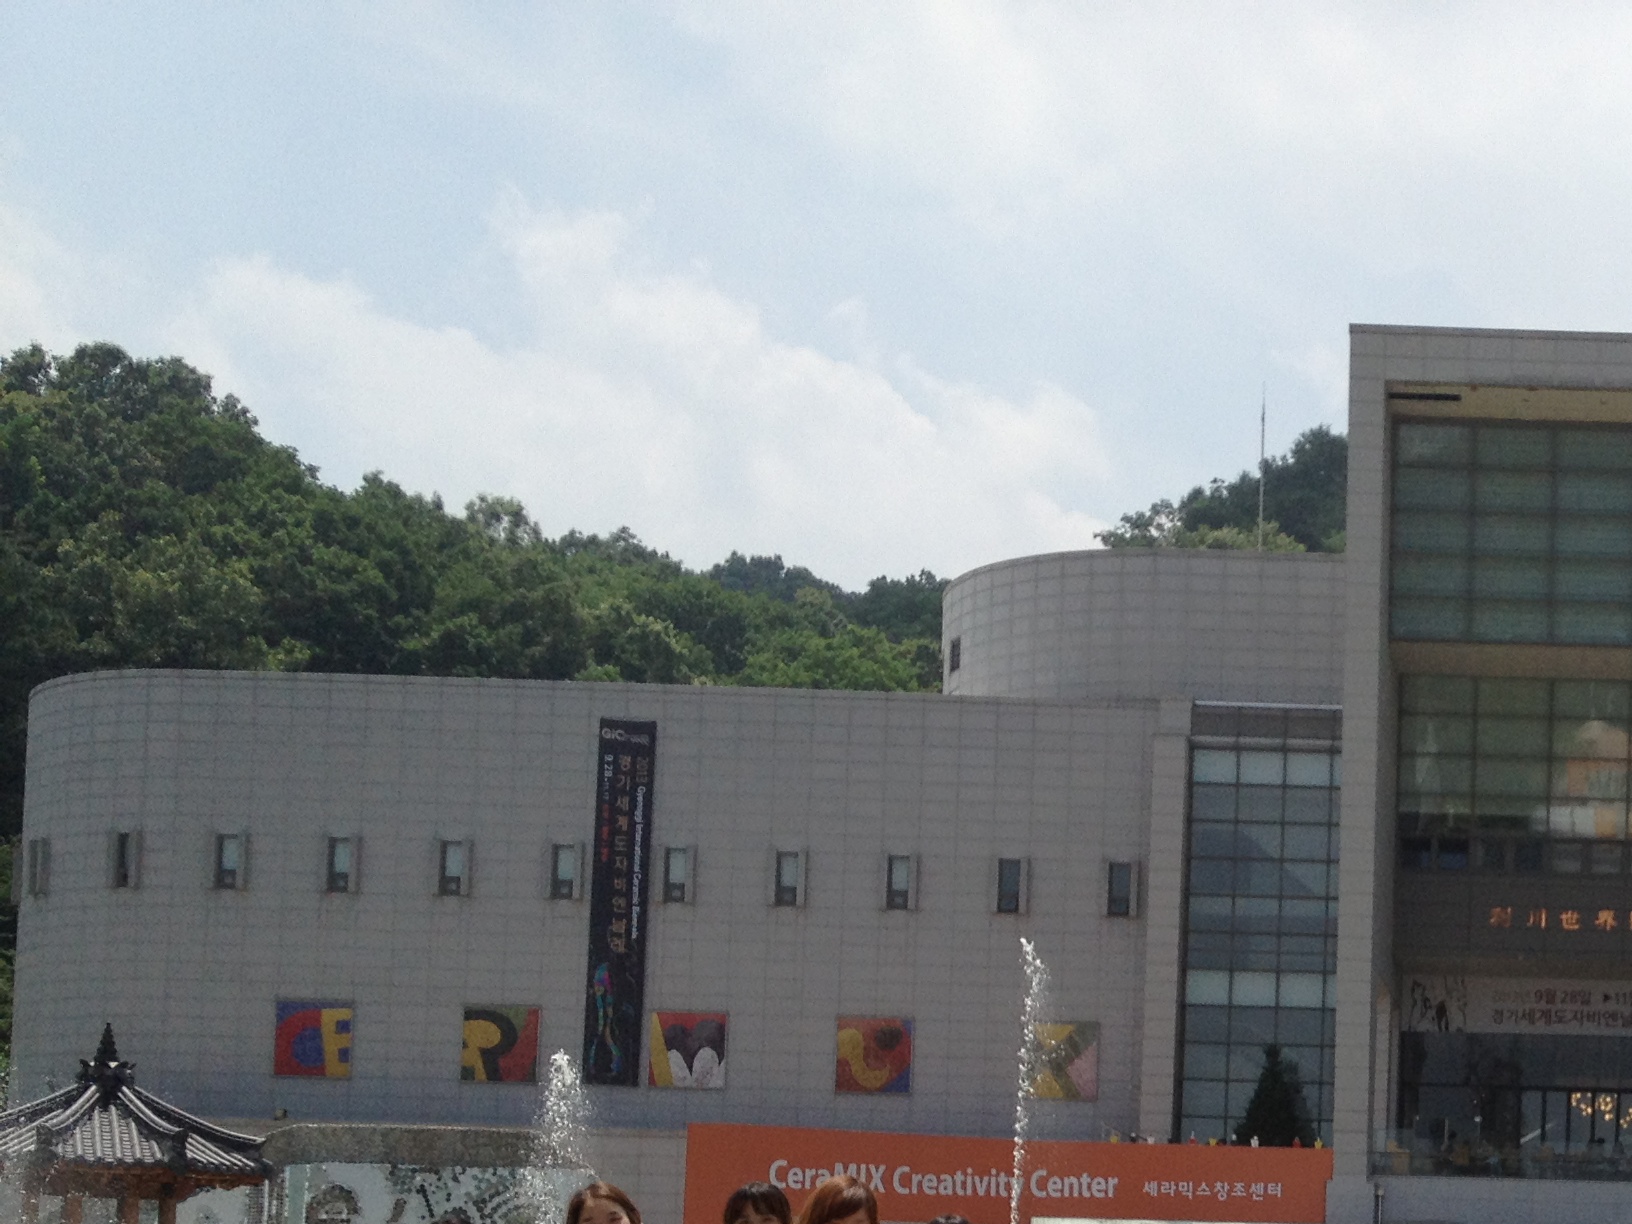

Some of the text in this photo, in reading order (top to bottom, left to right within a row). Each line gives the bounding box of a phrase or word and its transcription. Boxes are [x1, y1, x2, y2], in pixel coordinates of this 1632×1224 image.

[893, 1165, 1024, 1203] Creativity
[1030, 1169, 1118, 1198] Center
[1143, 1180, 1283, 1200] 세라믹스창조센터
